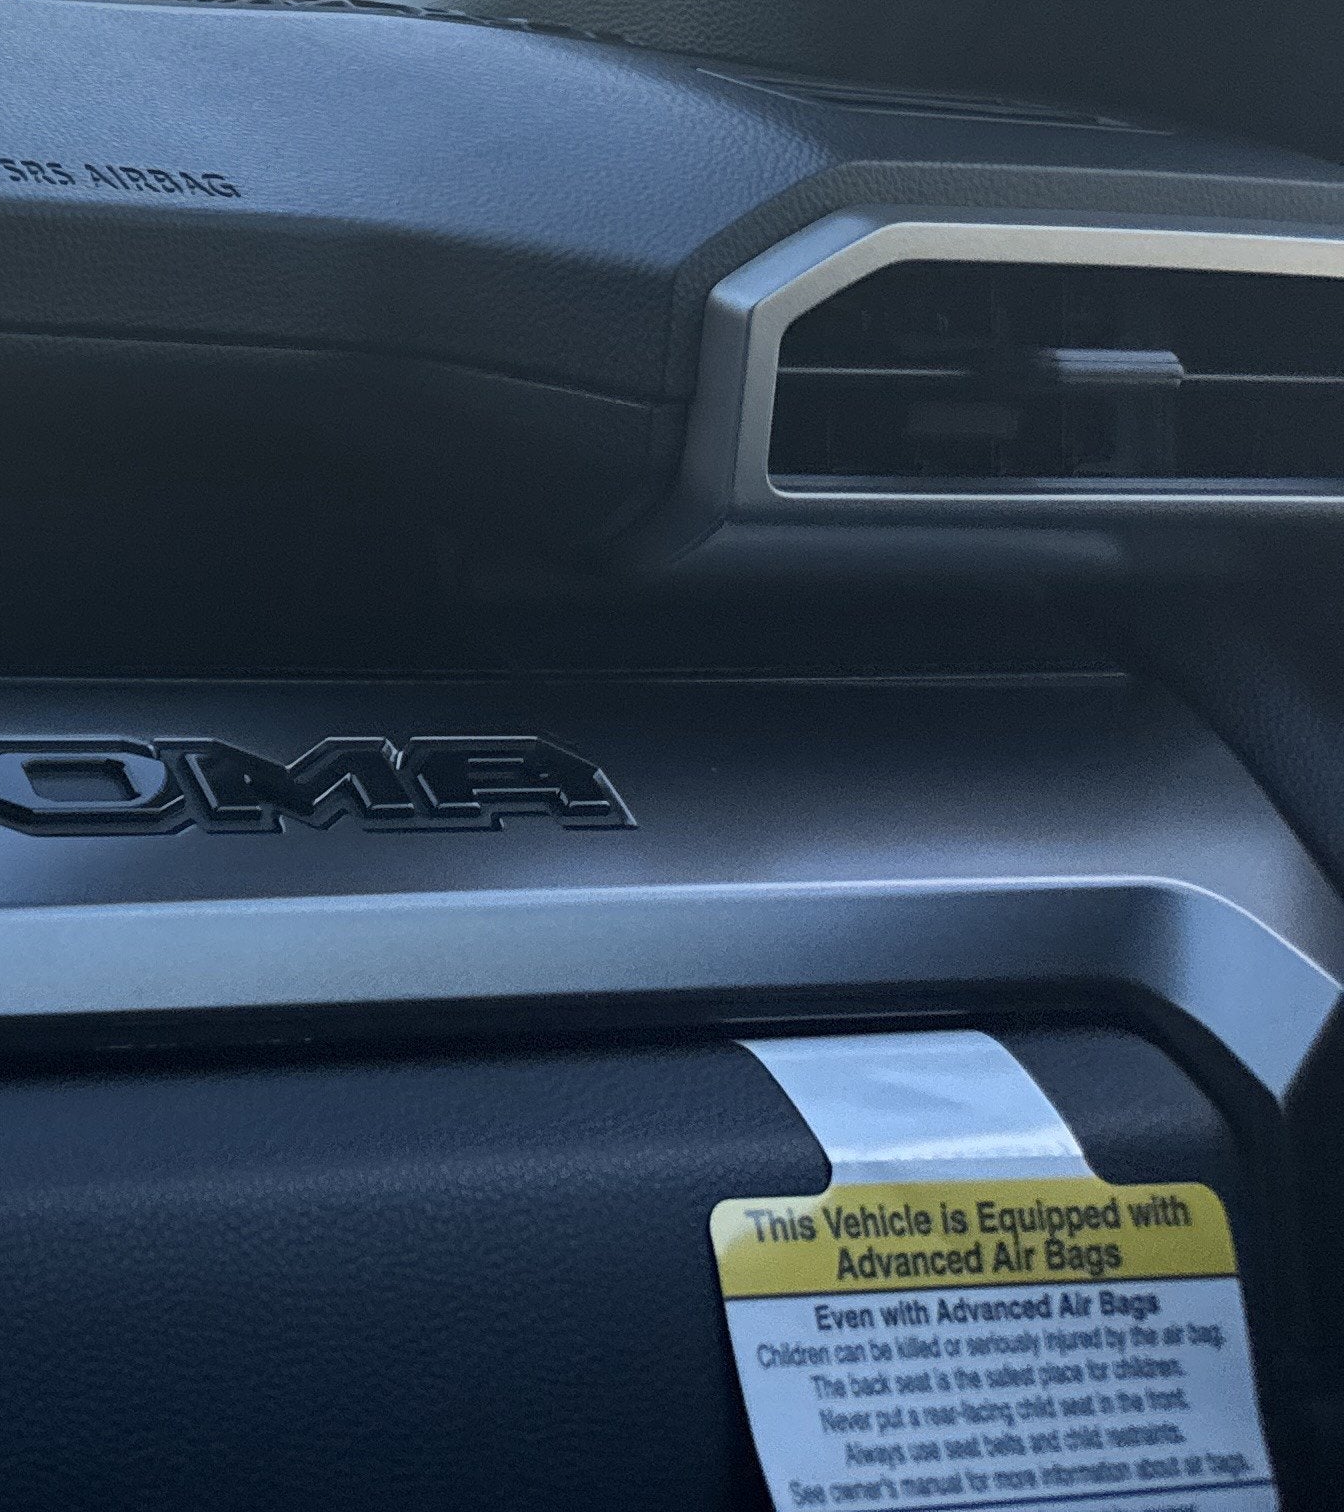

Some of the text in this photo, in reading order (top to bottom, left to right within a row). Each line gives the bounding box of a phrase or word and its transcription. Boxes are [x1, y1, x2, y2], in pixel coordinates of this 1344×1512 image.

[83, 163, 242, 198] AIRBAG
[745, 1194, 1193, 1243] This Vehicle is Equipped with
[837, 1237, 1124, 1281] Advanced Air Bags
[814, 1289, 1161, 1331] Even with Advanced Air Bags
[756, 1341, 830, 1369] Children
[834, 1344, 866, 1363] can
[869, 1340, 893, 1361] be
[895, 1335, 941, 1359] killed
[944, 1337, 962, 1357] or
[966, 1333, 1040, 1358] seriously
[1104, 1326, 1127, 1354] by
[1130, 1325, 1159, 1347] the
[812, 1373, 847, 1399] The
[849, 1371, 890, 1397] back
[954, 1367, 982, 1390] the
[819, 1407, 872, 1433] Never
[875, 1406, 904, 1437] put
[844, 1441, 906, 1470] Always
[788, 1480, 827, 1507] See
